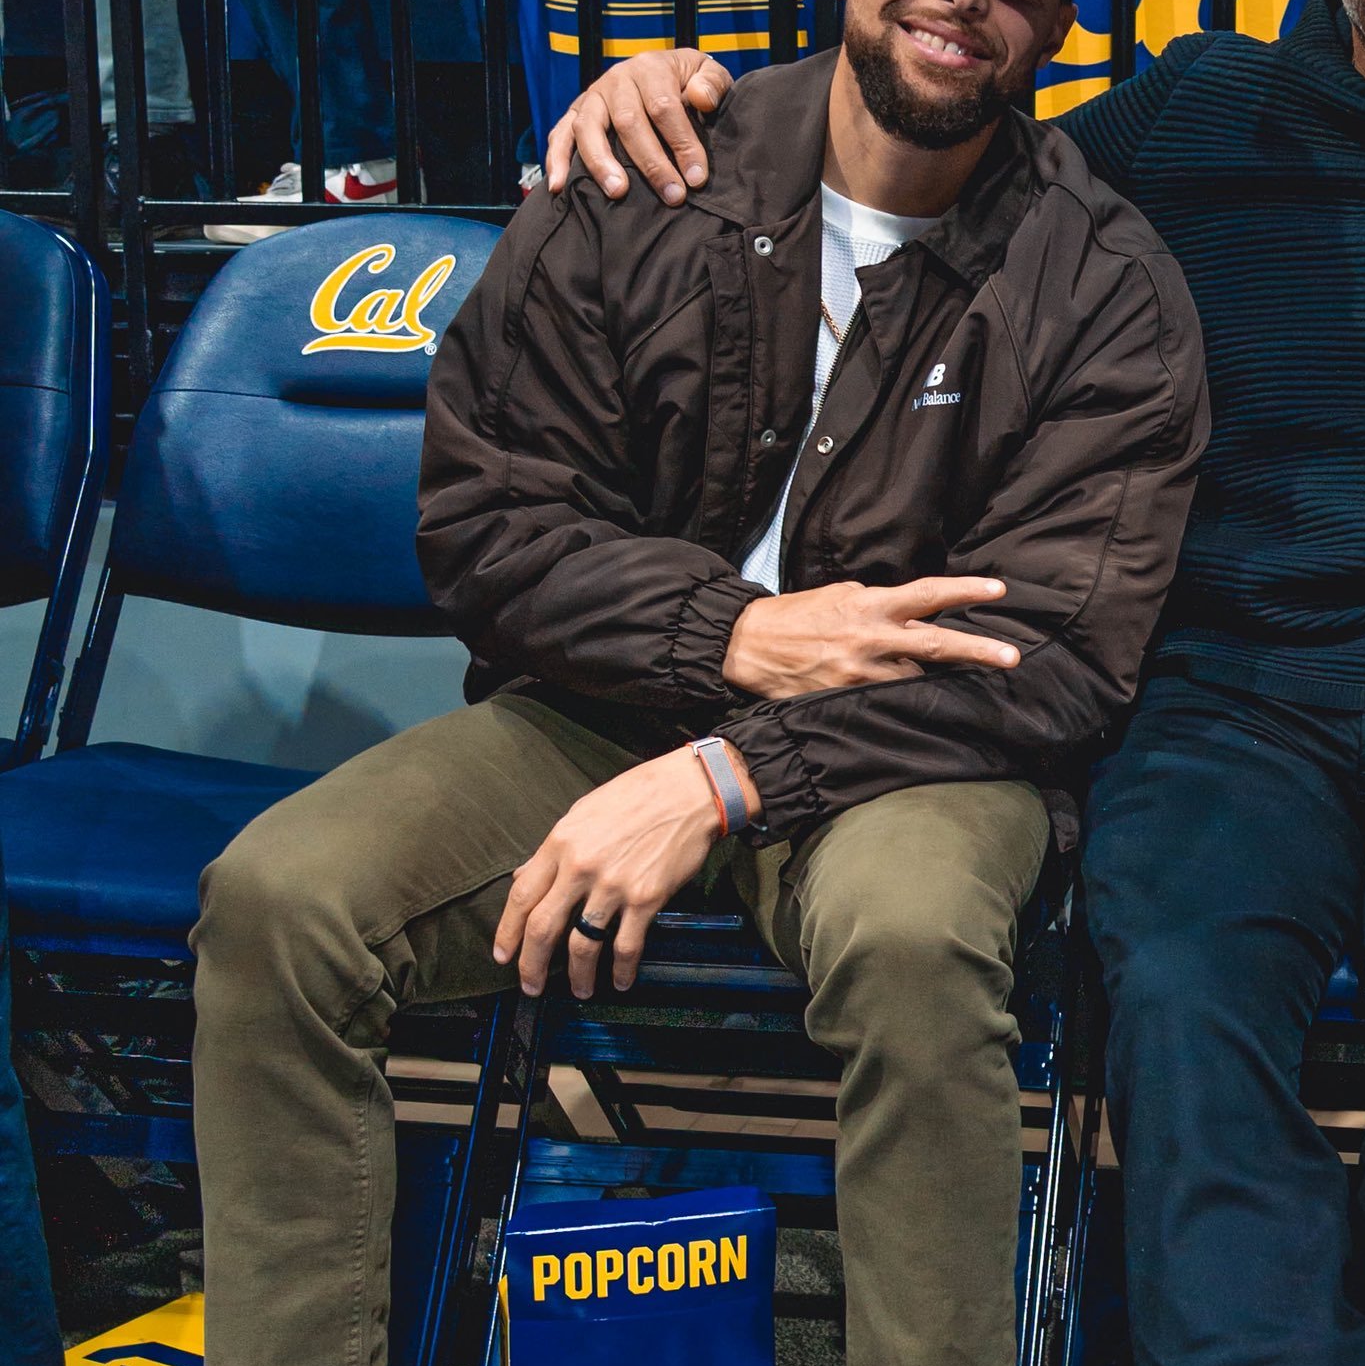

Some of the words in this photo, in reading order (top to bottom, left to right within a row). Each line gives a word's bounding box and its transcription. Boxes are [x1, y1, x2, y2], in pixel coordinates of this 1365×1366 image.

[302, 244, 456, 355] Cal
[922, 390, 961, 406] Balance
[533, 1235, 748, 1302] POPCORN
